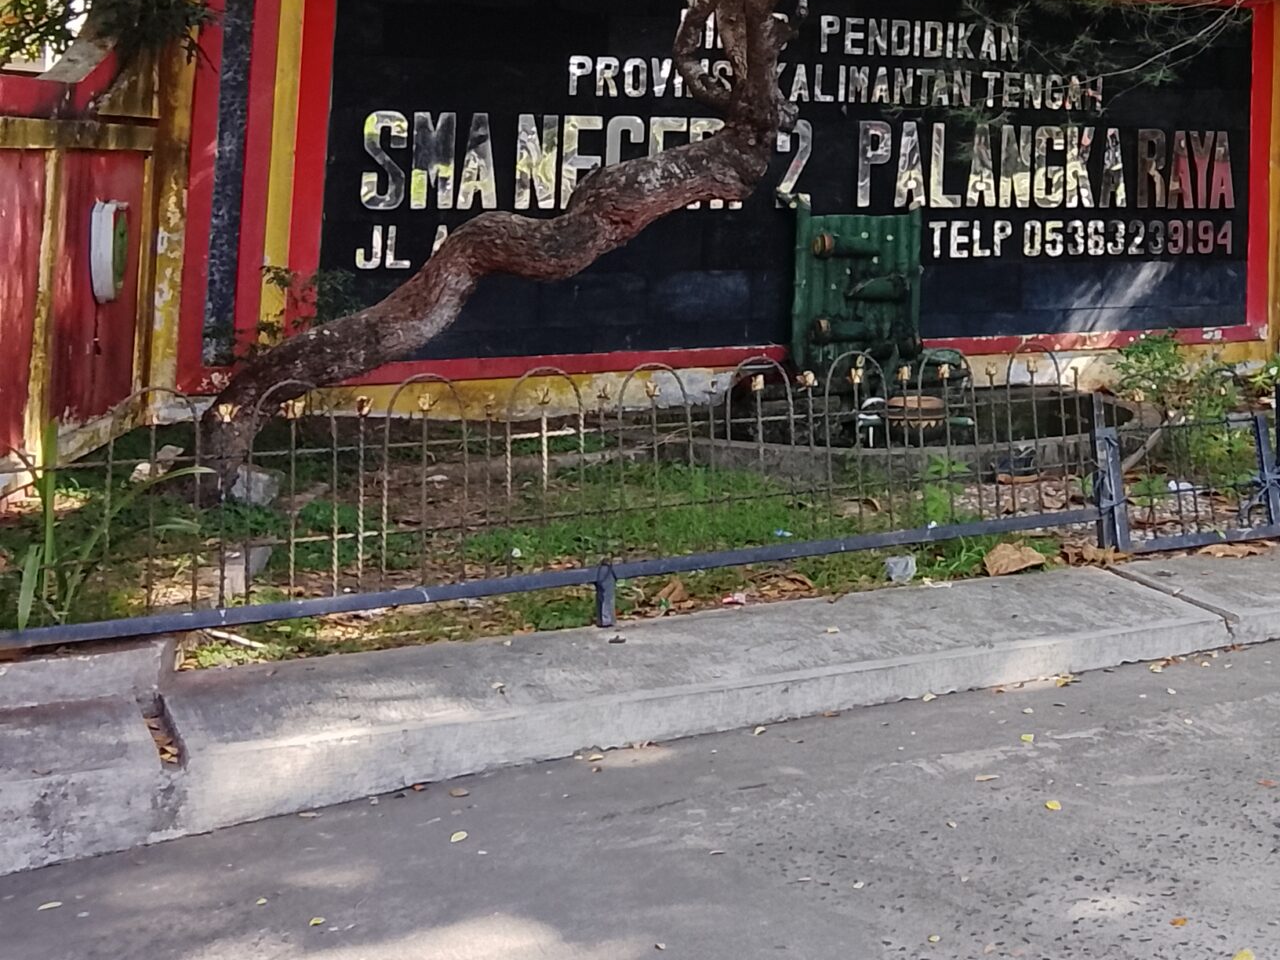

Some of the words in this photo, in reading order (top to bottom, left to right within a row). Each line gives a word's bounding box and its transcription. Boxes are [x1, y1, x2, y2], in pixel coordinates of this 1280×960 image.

[820, 14, 1020, 62] PENDIDIKAN
[982, 70, 1104, 111] TENGAH
[360, 109, 498, 210] SMA
[774, 118, 813, 209] 2
[1136, 127, 1236, 210] RAYA
[355, 224, 411, 270] JL
[928, 220, 1013, 259] TELP
[1022, 218, 1234, 257] 05363239194
